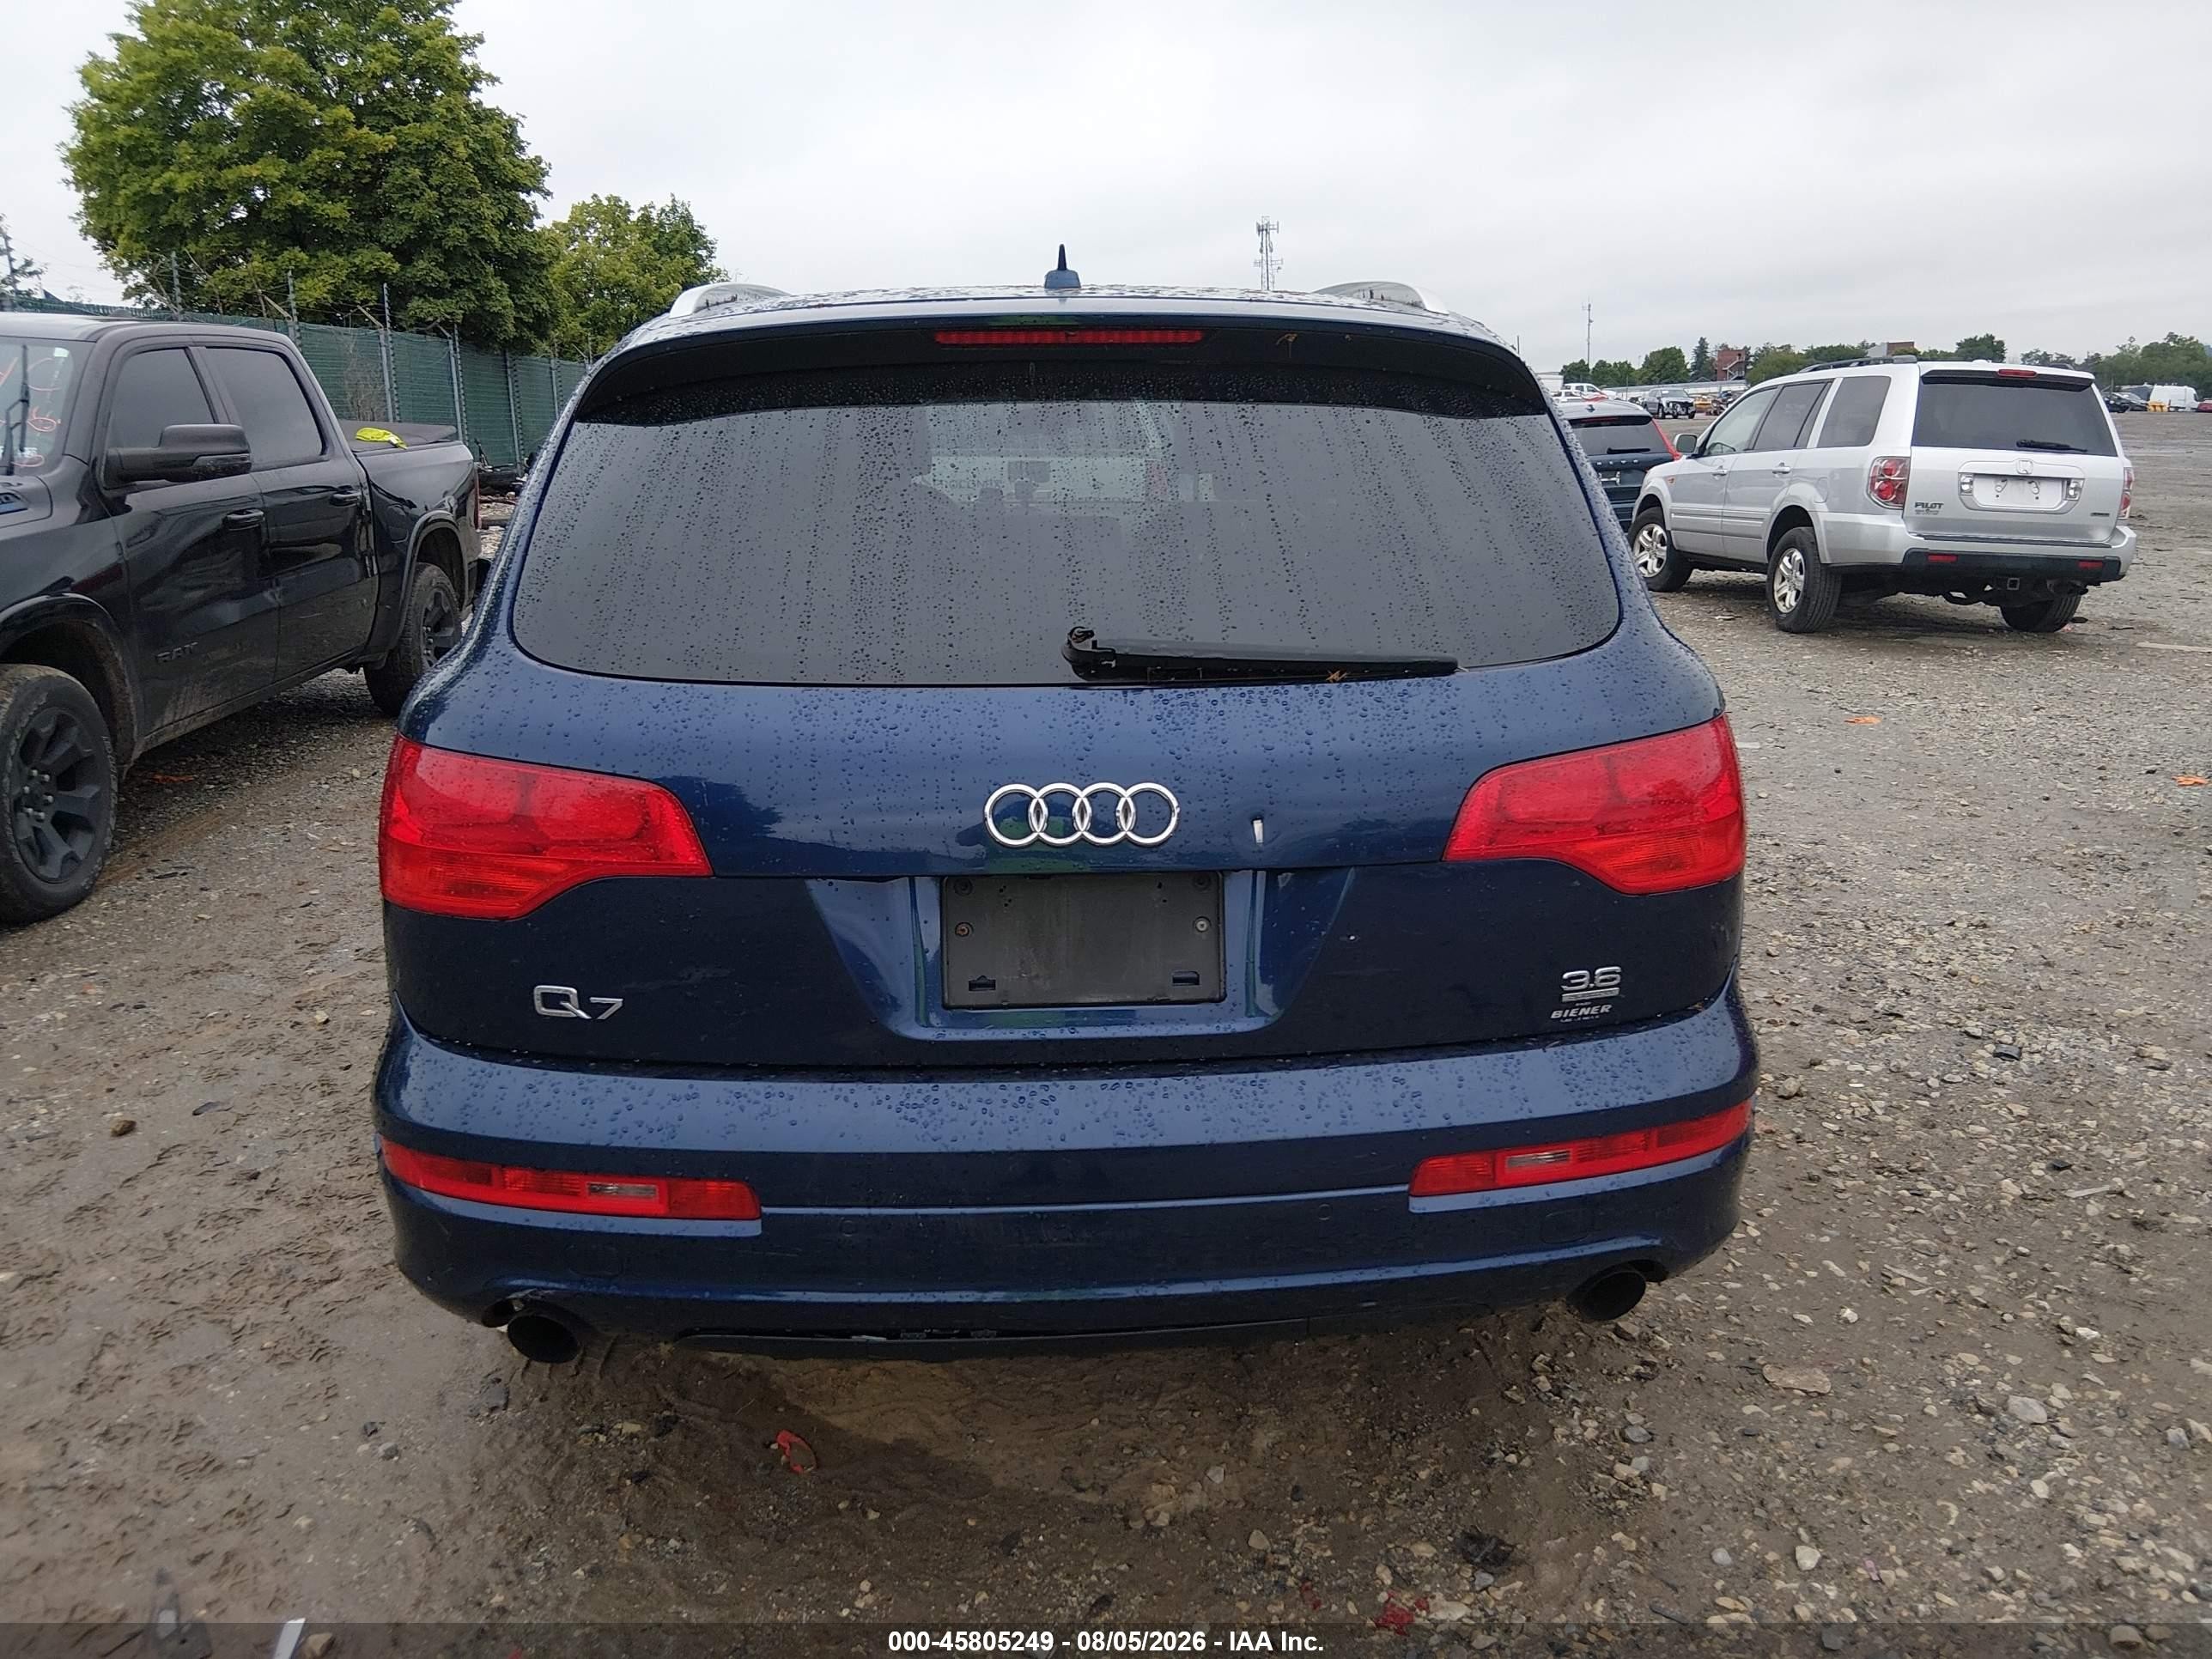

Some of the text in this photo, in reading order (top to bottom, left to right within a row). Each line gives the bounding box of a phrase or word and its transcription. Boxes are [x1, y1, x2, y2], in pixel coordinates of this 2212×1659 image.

[1561, 966, 1621, 991] 3.6
[533, 985, 623, 1019] Q7
[1550, 1004, 1613, 1019] BIENER
